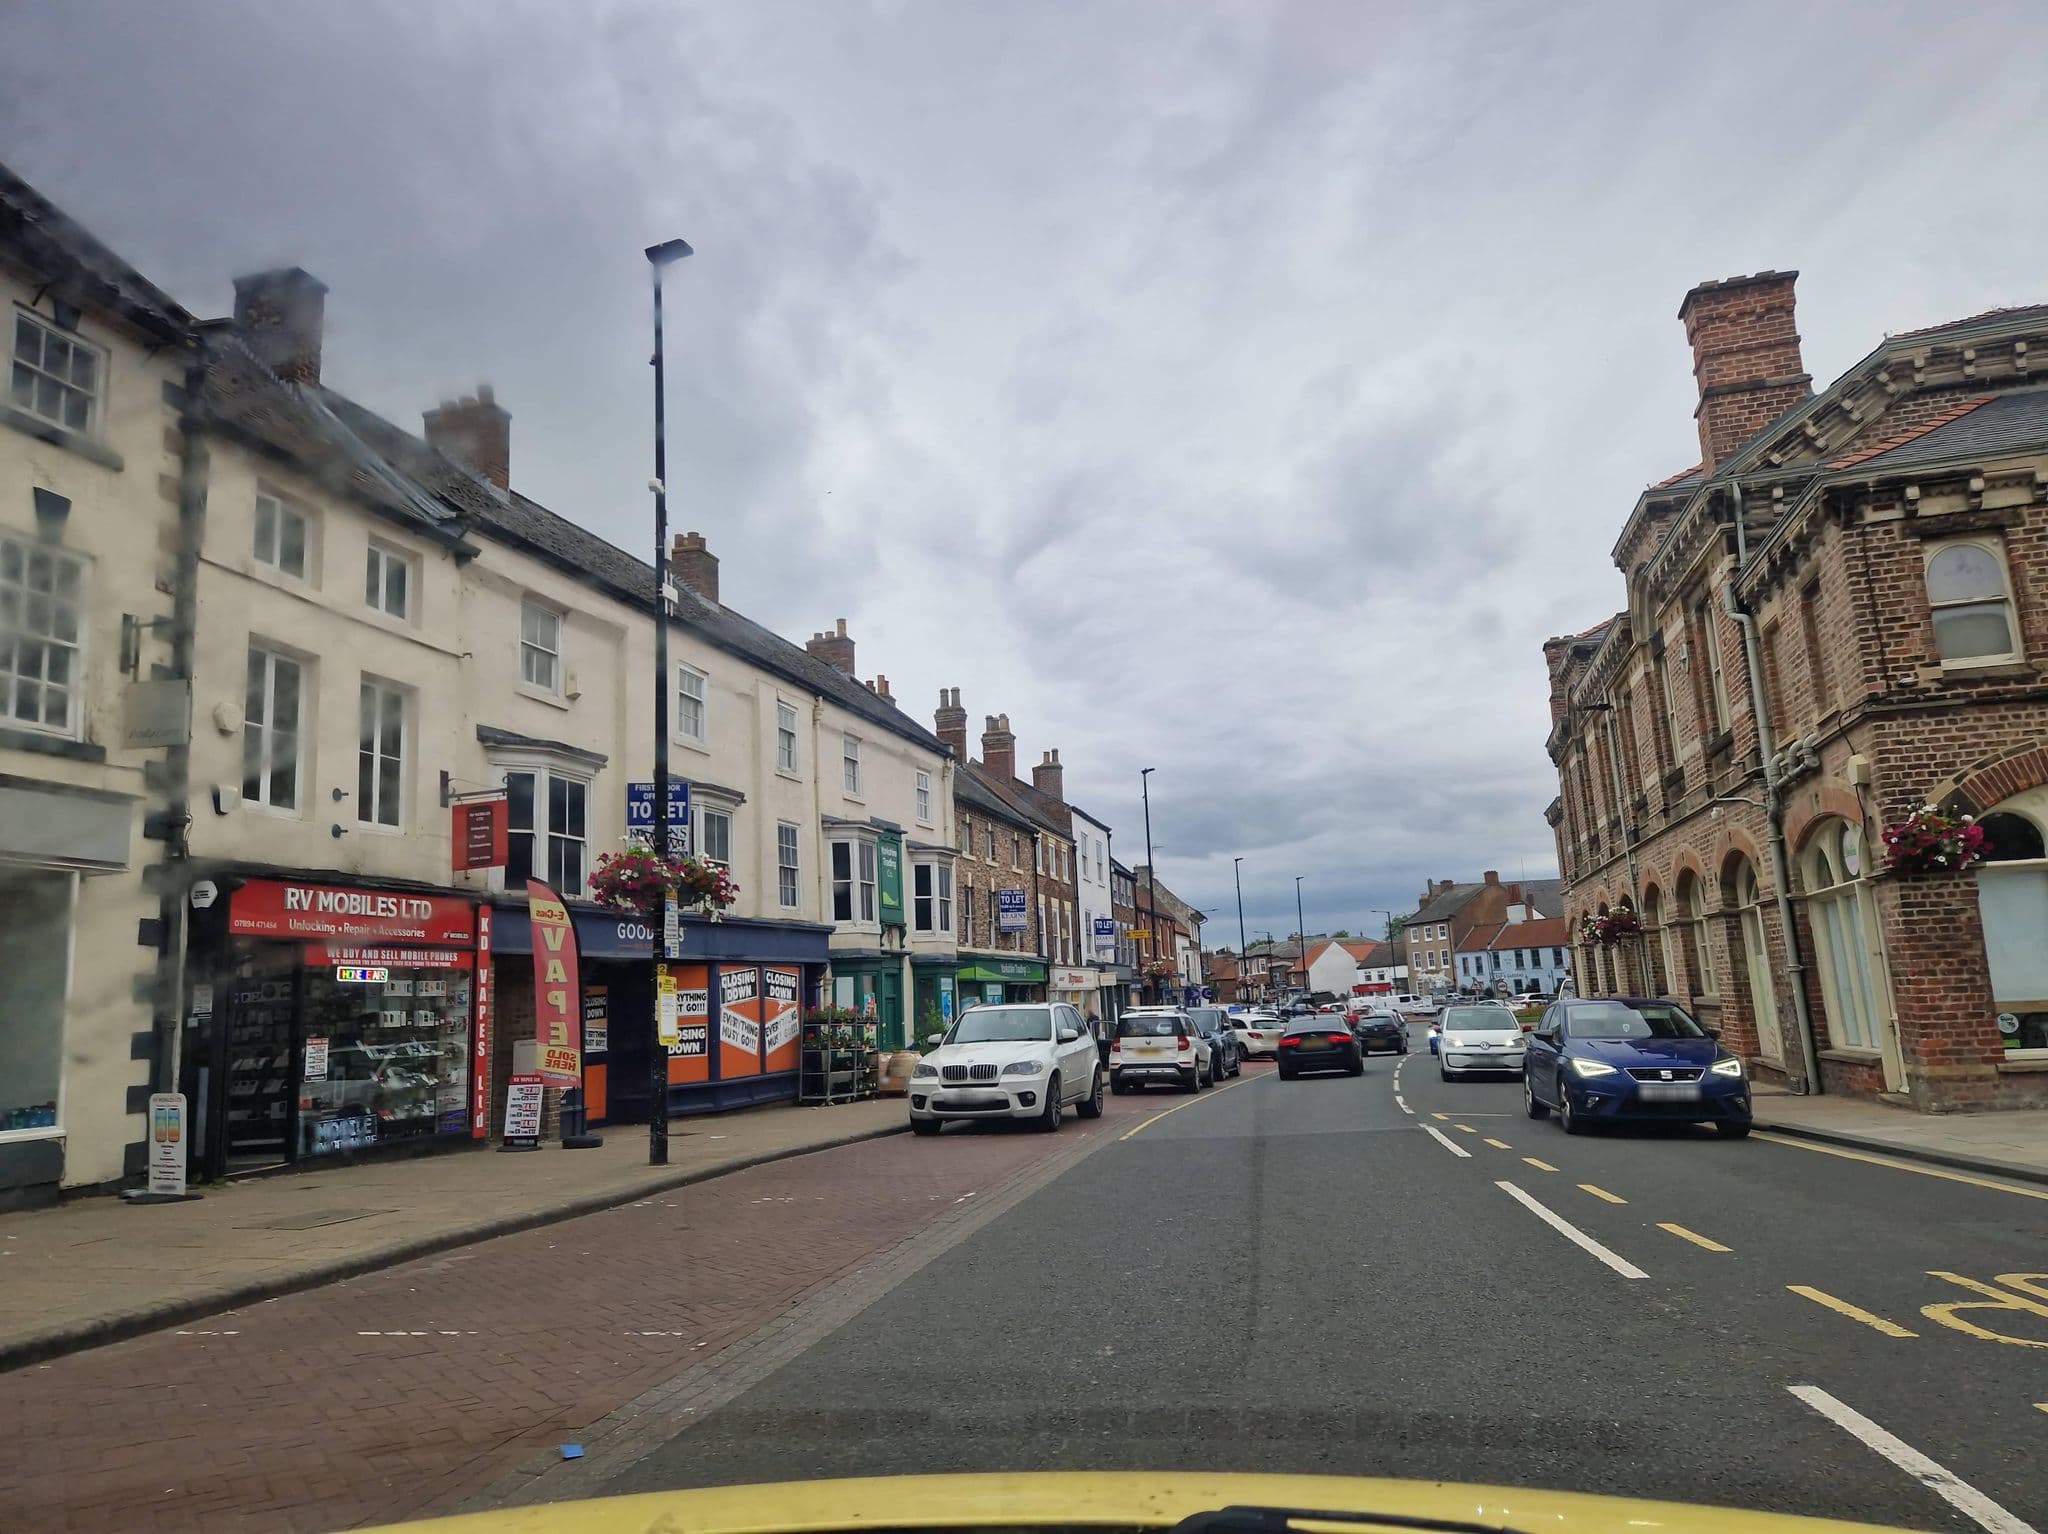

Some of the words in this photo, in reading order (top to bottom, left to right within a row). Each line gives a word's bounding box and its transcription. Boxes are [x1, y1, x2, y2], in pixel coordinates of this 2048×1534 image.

[630, 801, 652, 818] TO
[668, 801, 686, 818] ET
[285, 887, 313, 911] RV
[319, 890, 397, 918] MOBILES
[400, 899, 433, 920] LTD
[1000, 895, 1010, 904] TO
[1011, 895, 1025, 904] LET
[289, 918, 336, 934] Unlocking
[343, 923, 370, 936] Repair
[378, 924, 426, 939] Accessories
[1095, 920, 1103, 929] TO
[1103, 920, 1113, 929] LET
[343, 949, 360, 959] BUY
[361, 950, 379, 960] AND
[380, 950, 398, 960] SELL
[400, 951, 428, 961] MOBILE
[430, 952, 458, 962] PHONES
[722, 971, 756, 989] CLOSING
[766, 971, 796, 988] CLOSING
[677, 992, 707, 1002] RYTHING
[727, 985, 752, 1002] DOWN
[770, 985, 792, 999] DOWN
[478, 968, 488, 1057] VAPES
[686, 1003, 705, 1012] GO!!!
[723, 1012, 758, 1038] EVERYTHING
[678, 1028, 706, 1040] OSING
[722, 1025, 740, 1043] MUST
[668, 1041, 700, 1055] DOWN
